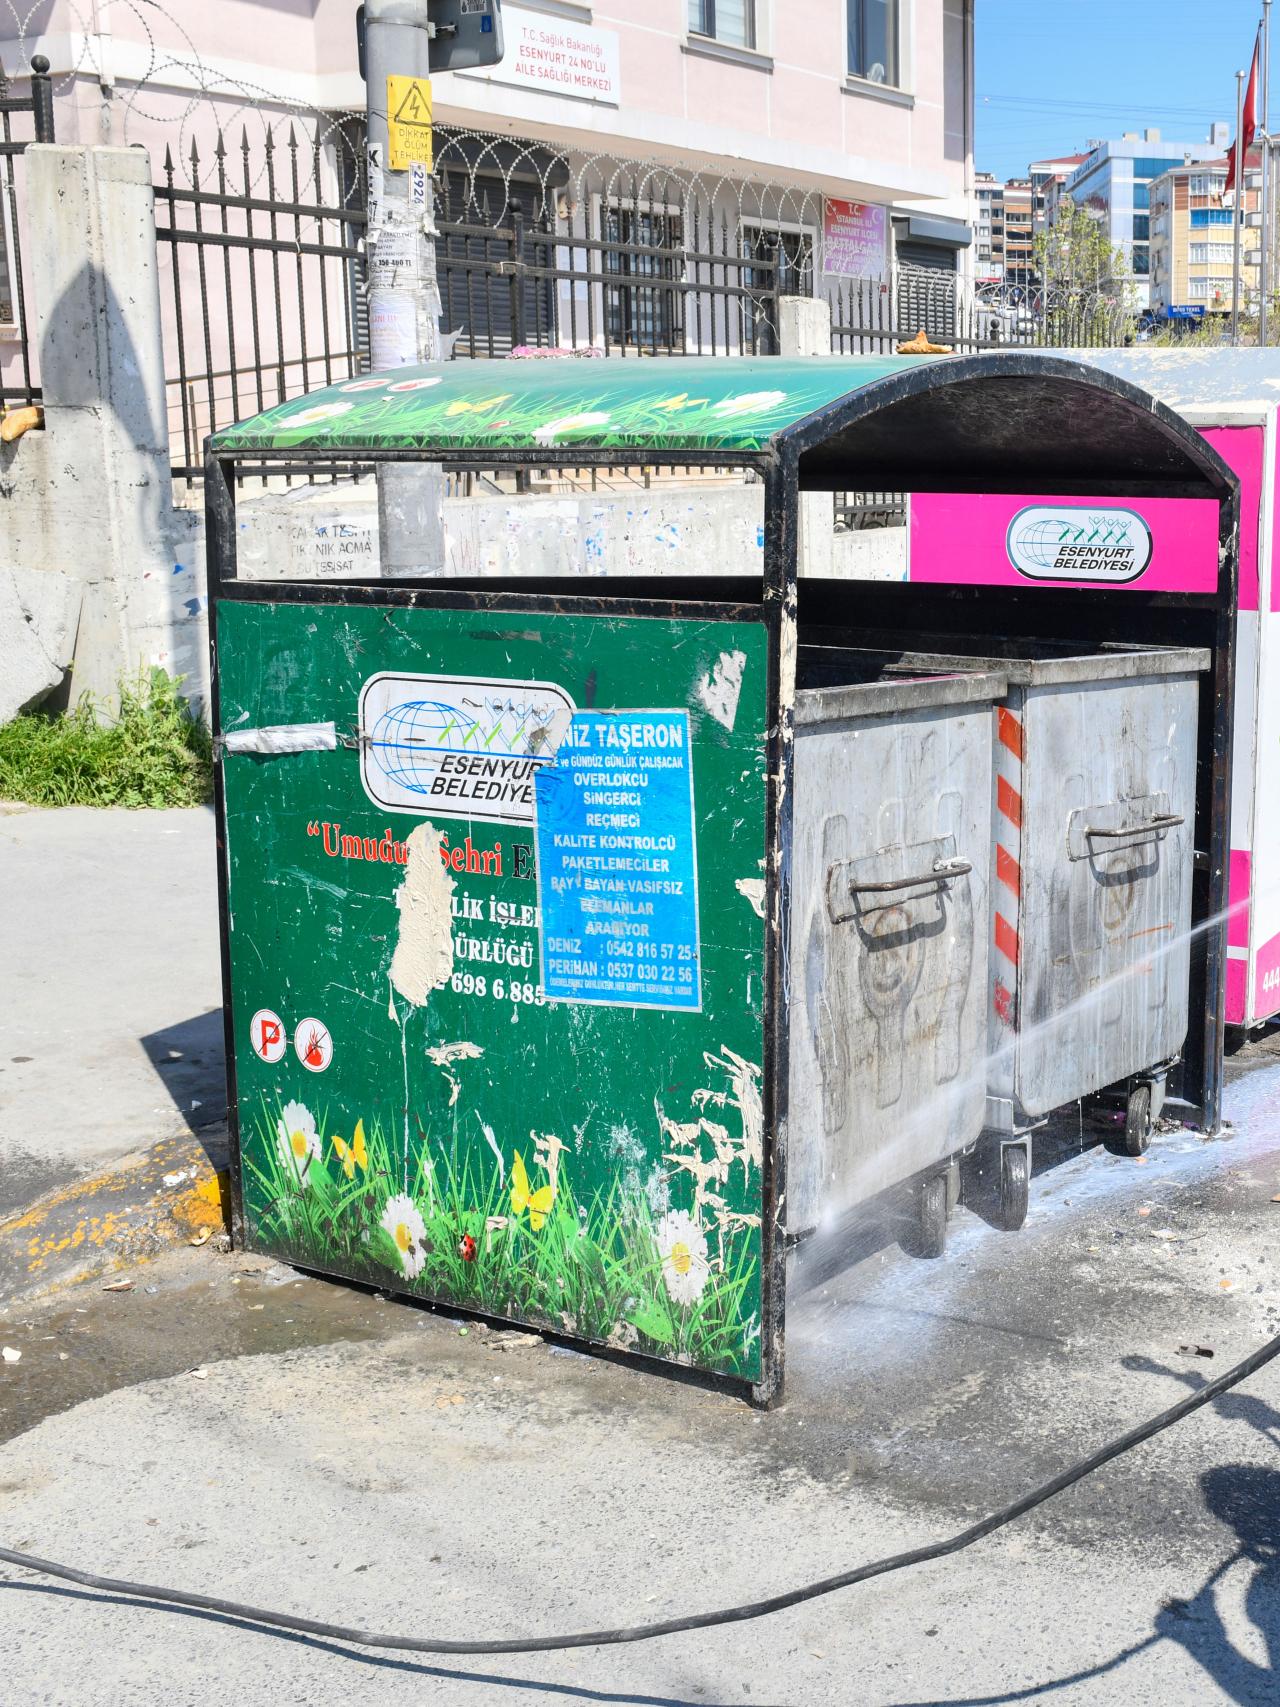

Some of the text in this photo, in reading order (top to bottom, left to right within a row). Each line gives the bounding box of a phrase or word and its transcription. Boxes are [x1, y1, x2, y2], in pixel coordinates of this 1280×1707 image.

[539, 31, 566, 48] Sağlık
[566, 37, 604, 58] Bakanlığı
[519, 45, 606, 73] ESENYURT 24 NO'LU
[1058, 546, 1134, 559] ESENYURT
[1053, 557, 1136, 572] BELEDİYESİ
[561, 724, 683, 754] NİZ TAŞERON
[440, 754, 543, 781] ESENYUR
[571, 753, 603, 768] GÜNDÜZ
[605, 754, 637, 769] GÜNLÜK
[430, 775, 533, 804] BELEDİYE
[600, 835, 676, 850] KONTROLCÜ
[628, 880, 683, 895] VASIFSIZ
[606, 940, 634, 957] 0542
[636, 943, 657, 958] 816
[660, 944, 674, 959] 57
[677, 945, 692, 960] 25
[607, 962, 634, 979] 0537
[637, 964, 658, 980] 030
[661, 966, 675, 981] 22
[678, 967, 692, 982] 56
[1263, 968, 1280, 992] 444
[452, 972, 487, 997] 698
